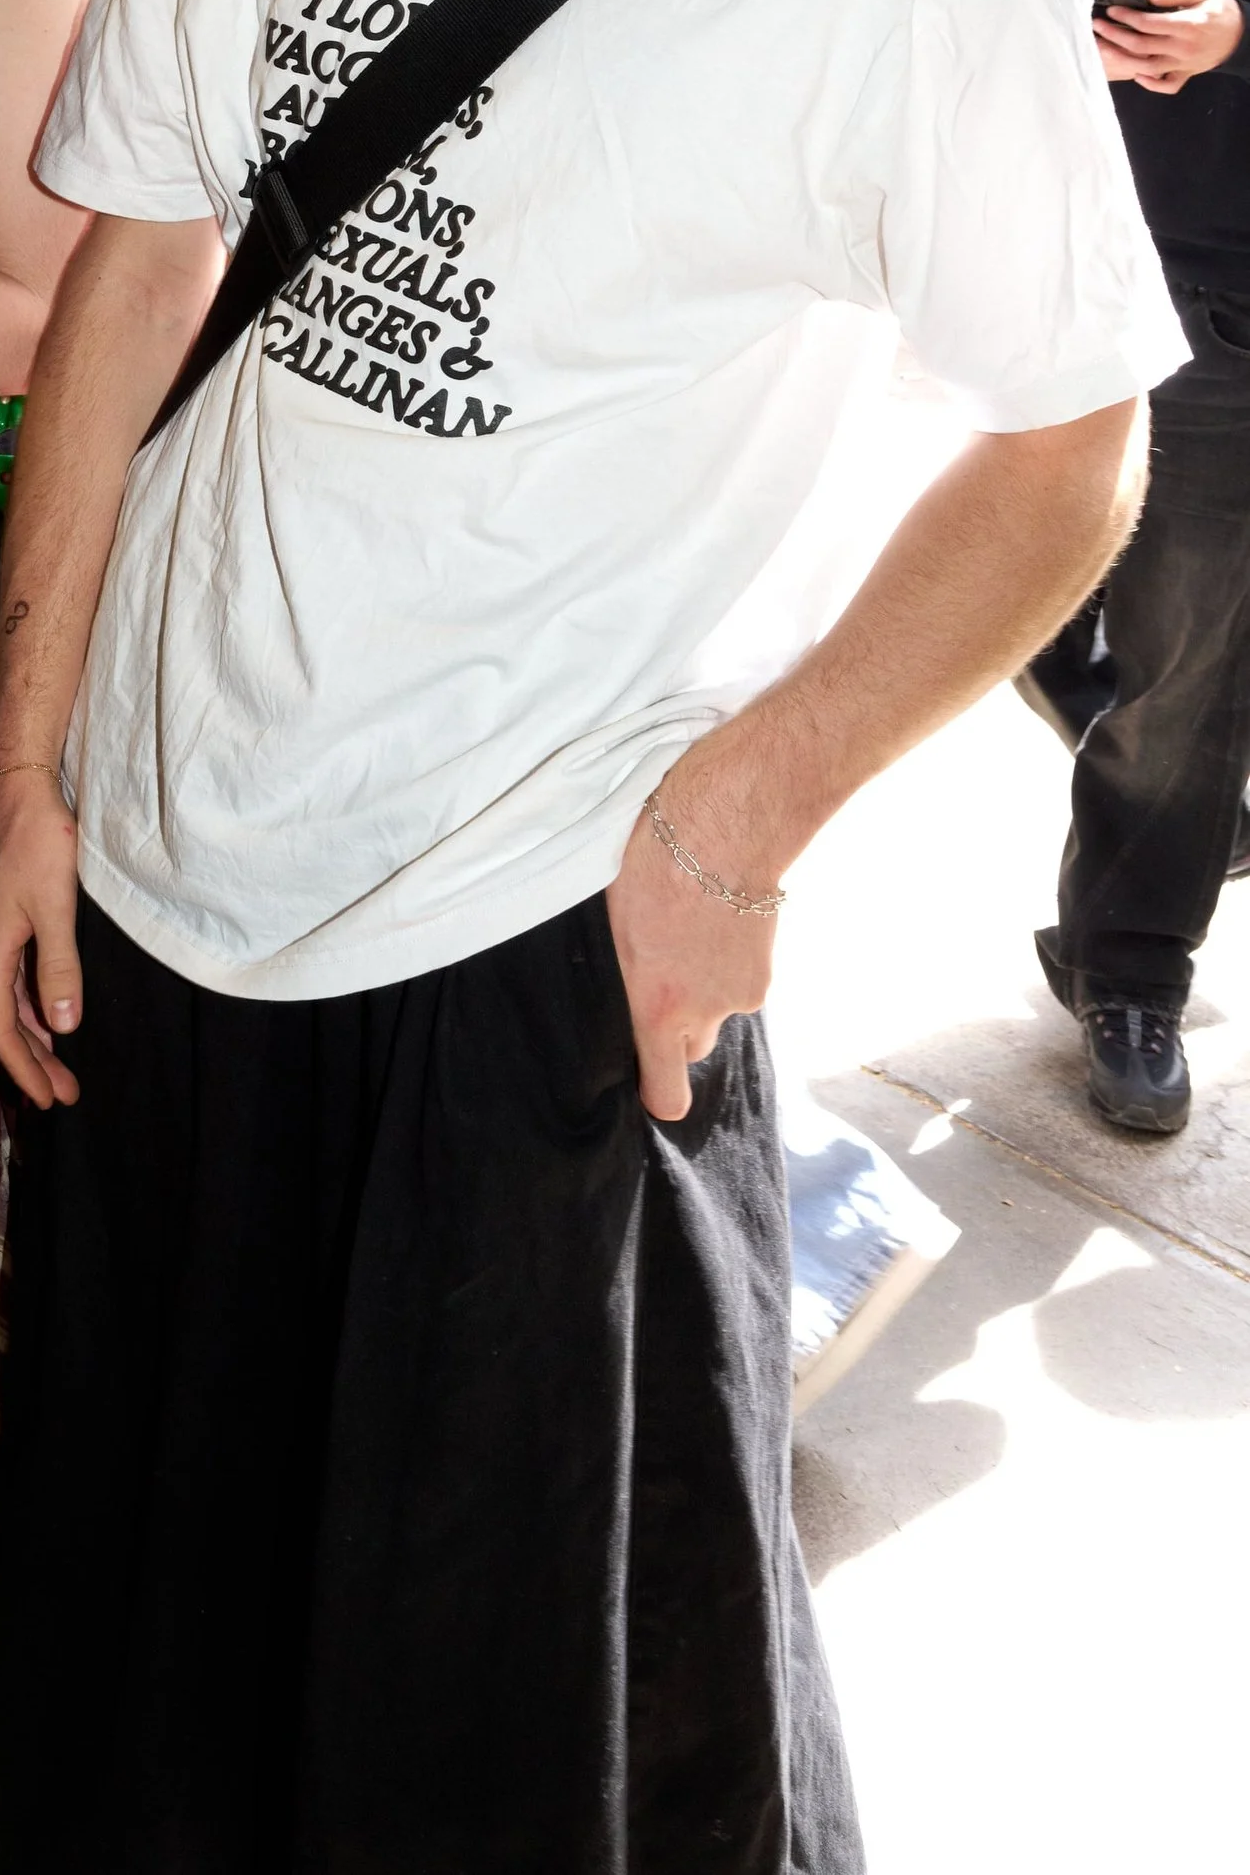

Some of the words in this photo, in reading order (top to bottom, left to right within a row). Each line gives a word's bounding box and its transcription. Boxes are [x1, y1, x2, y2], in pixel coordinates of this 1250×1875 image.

[261, 315, 513, 437] CALLINAN
[278, 267, 441, 364] ANGES
[440, 336, 493, 380] &
